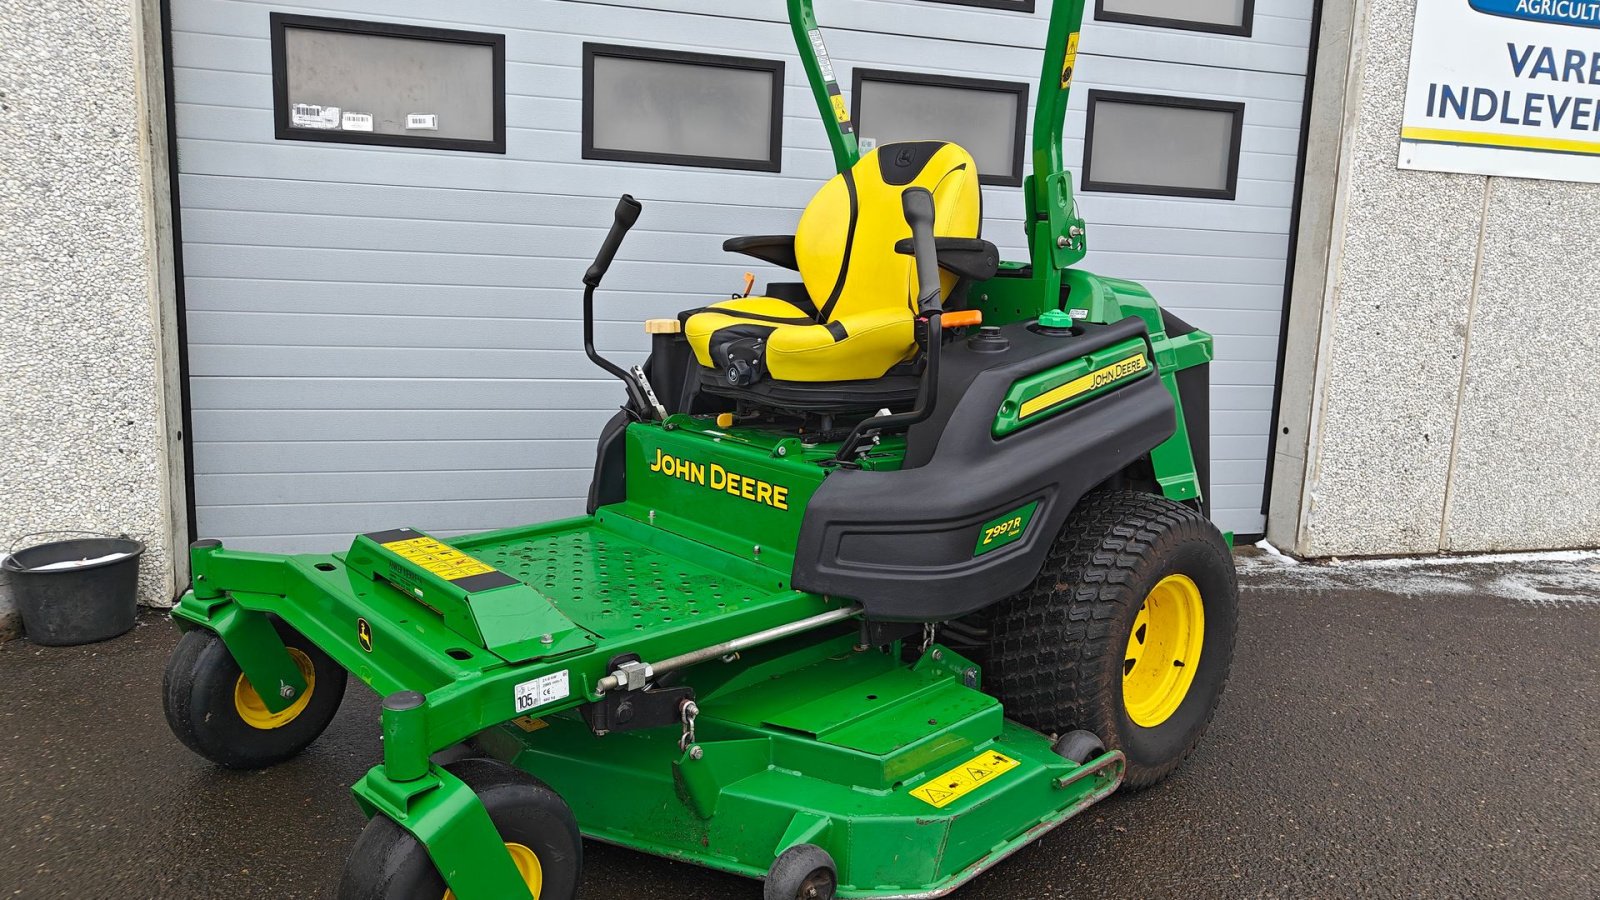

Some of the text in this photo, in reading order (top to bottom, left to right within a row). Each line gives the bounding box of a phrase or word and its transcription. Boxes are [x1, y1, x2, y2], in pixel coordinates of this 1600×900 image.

[1516, 0, 1600, 21] AGRICULT
[1090, 358, 1141, 390] JOHN DEERE
[650, 448, 789, 511] JOHN DEERE
[983, 516, 1021, 545] Z997R
[517, 693, 533, 709] 105
